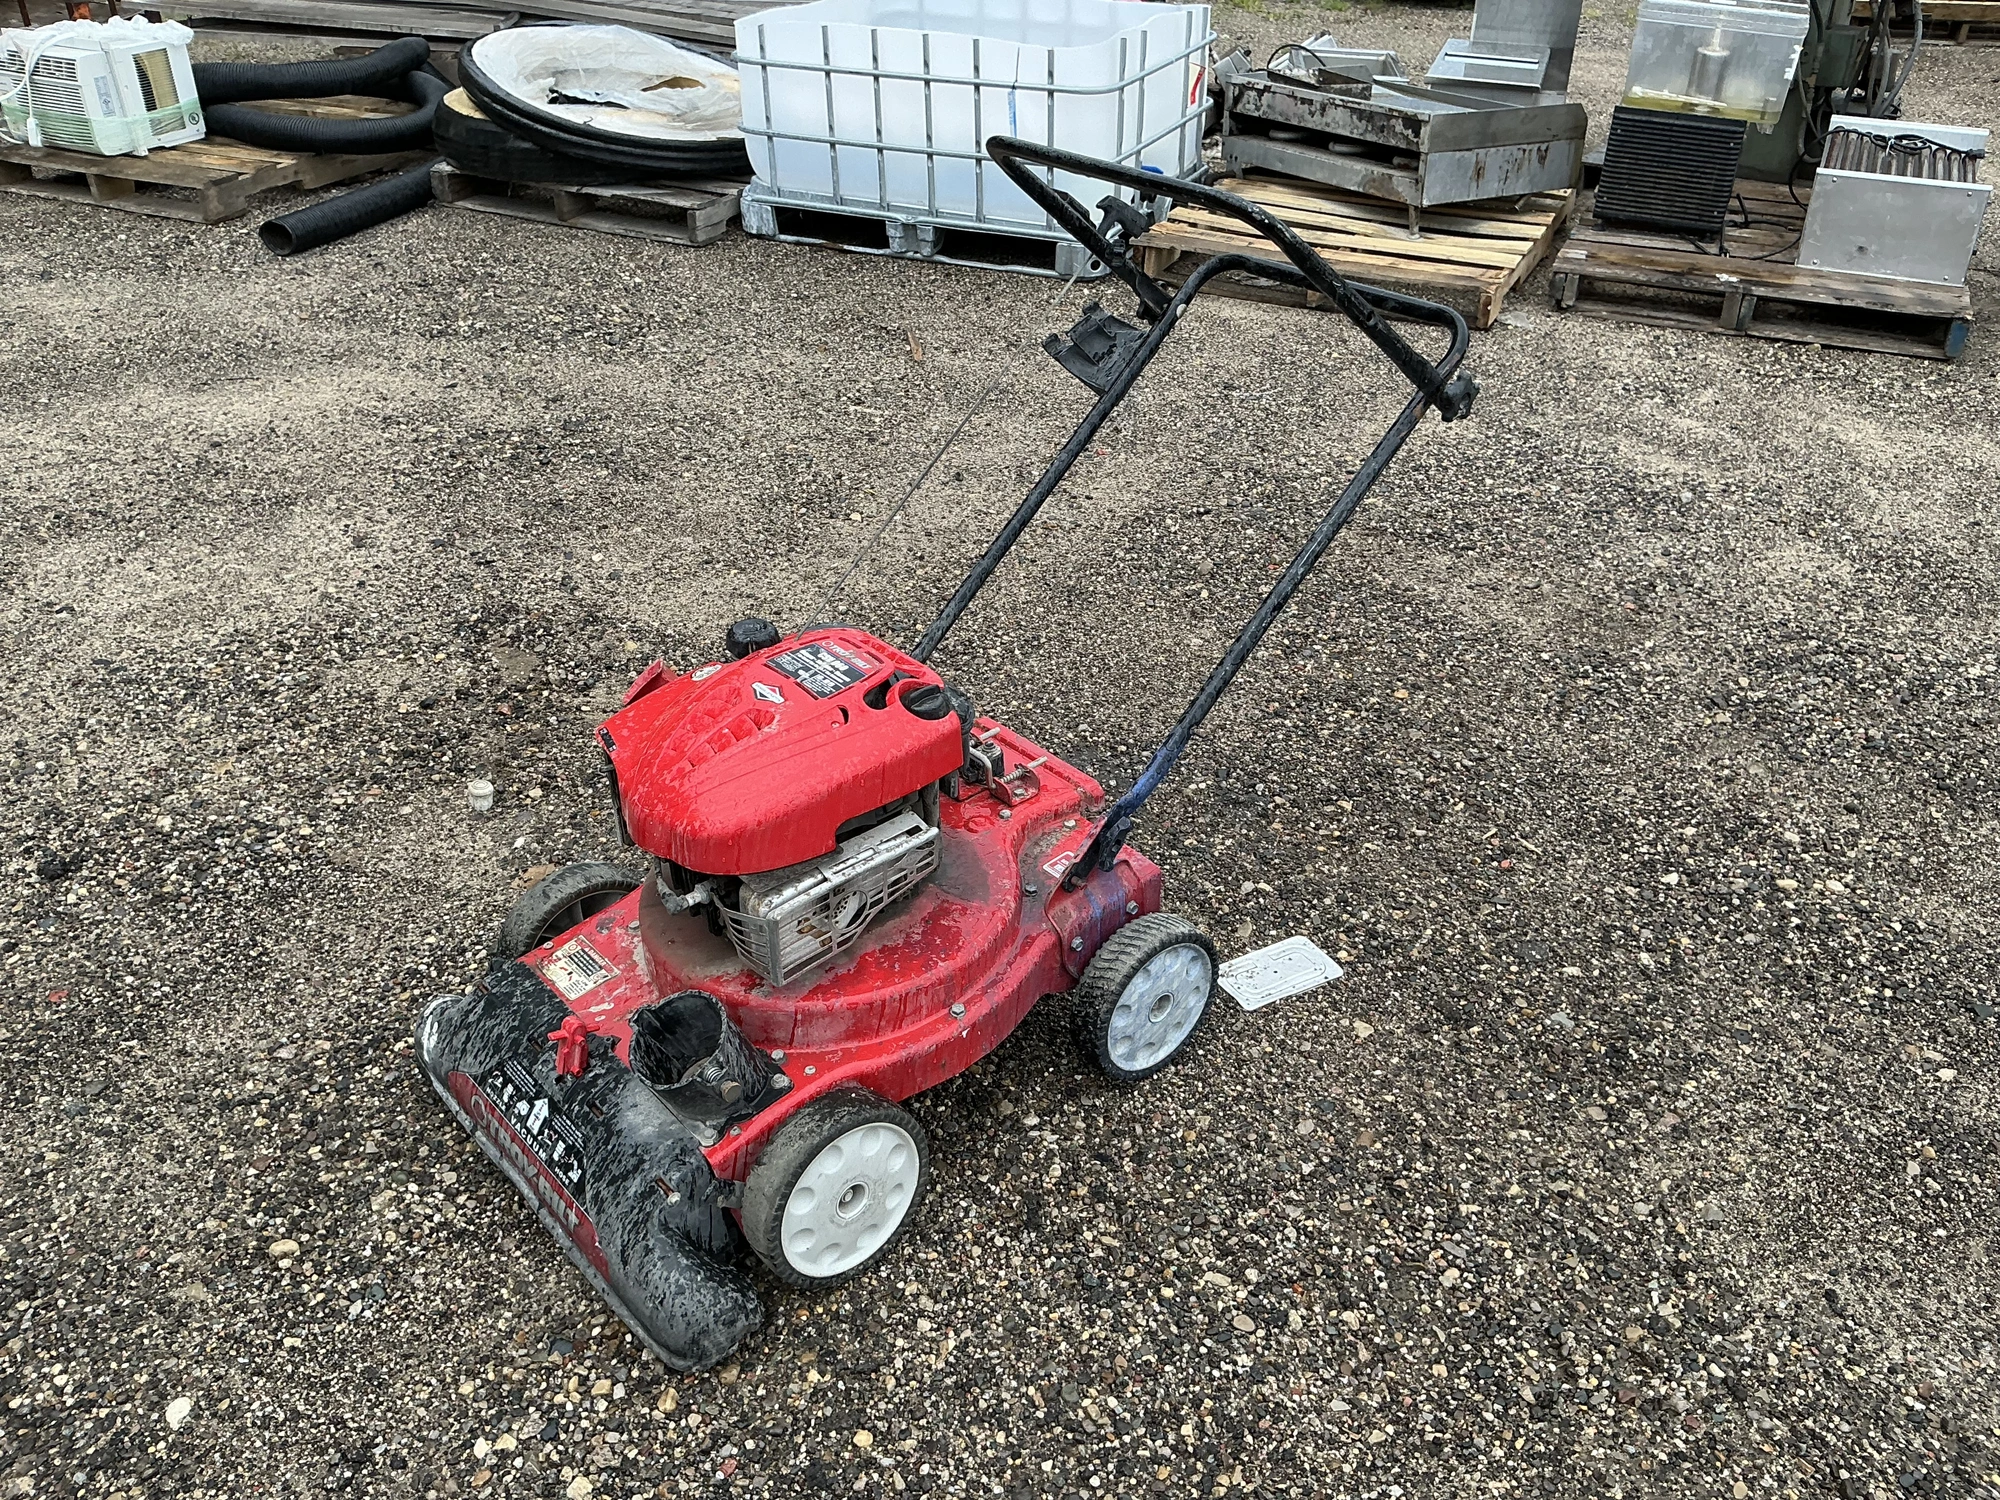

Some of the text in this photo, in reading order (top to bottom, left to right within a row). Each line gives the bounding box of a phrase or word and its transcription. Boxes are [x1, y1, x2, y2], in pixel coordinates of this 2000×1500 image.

[486, 1086, 507, 1112] NOZZLE
[510, 1115, 547, 1161] VACUUM
[488, 1113, 580, 1232] TROY-BILT
[554, 1166, 570, 1186] HOSE
